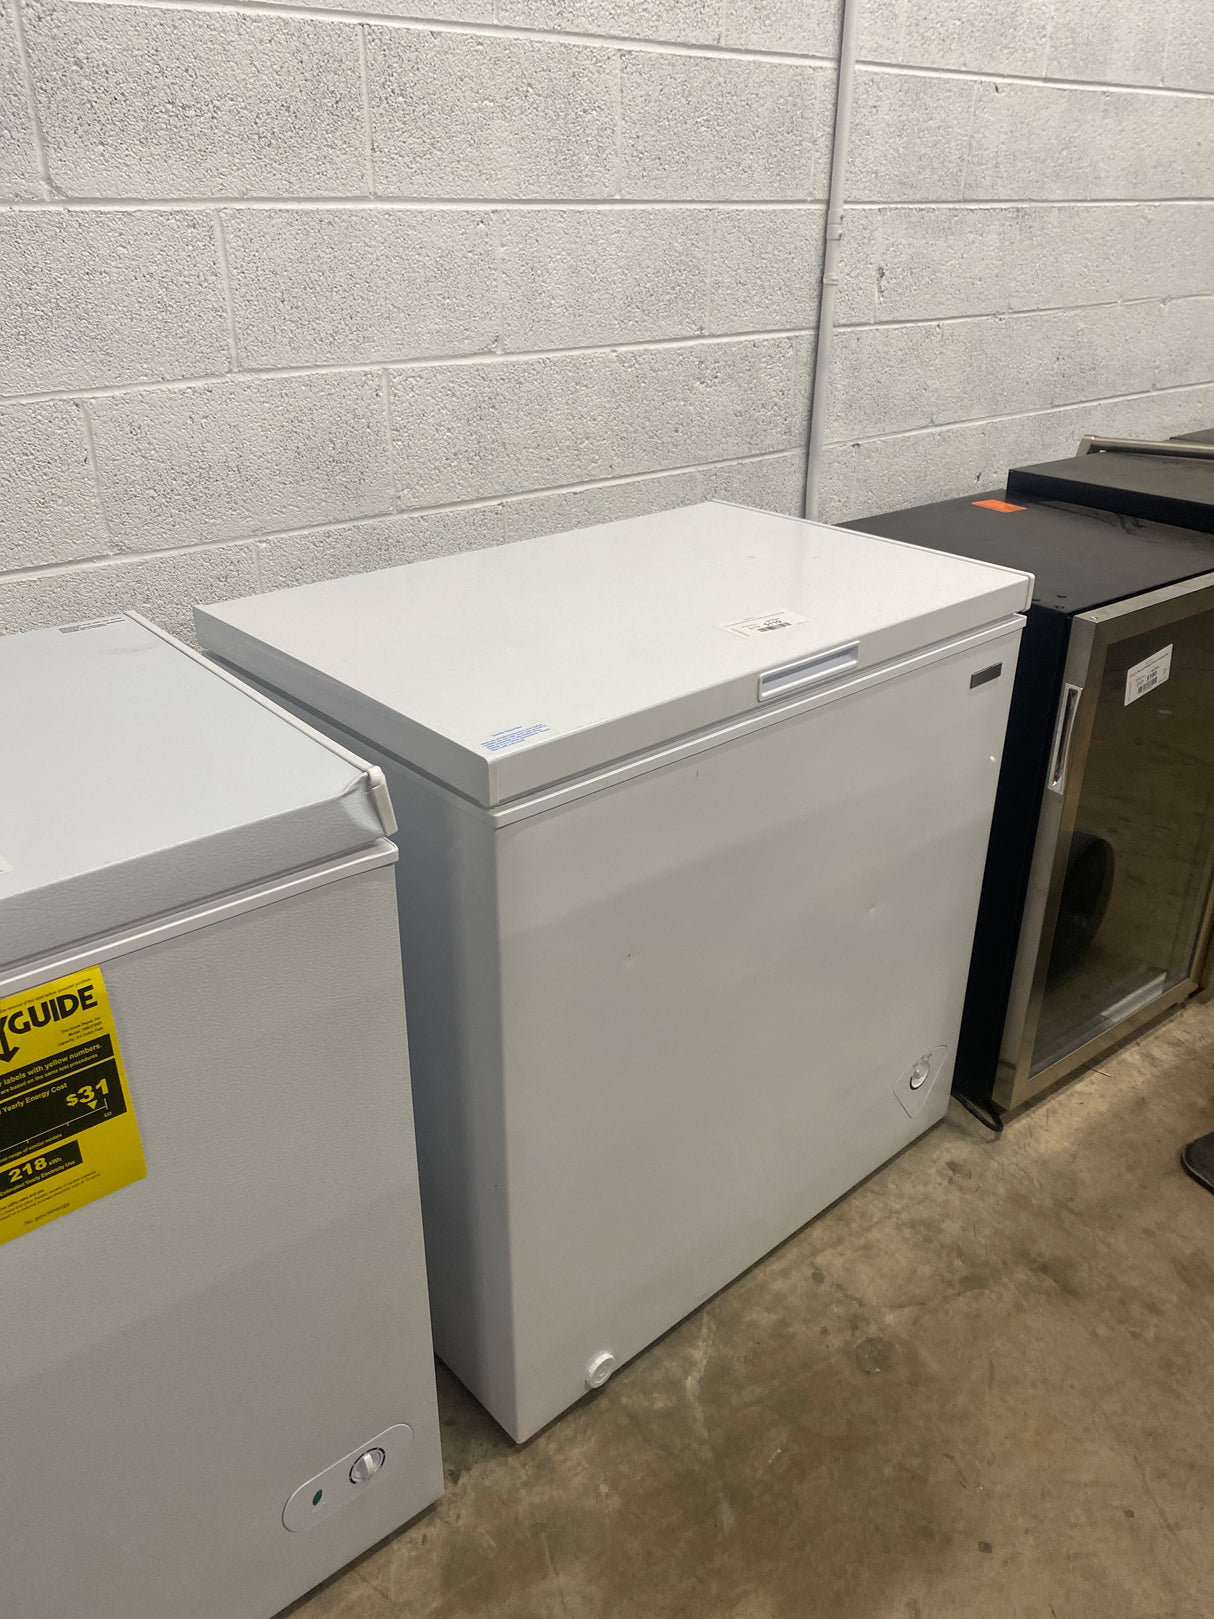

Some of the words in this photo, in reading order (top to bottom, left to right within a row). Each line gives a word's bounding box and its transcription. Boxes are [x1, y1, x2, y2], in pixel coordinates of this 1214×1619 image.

[4, 1072, 26, 1085] labels
[28, 1065, 44, 1076] with
[45, 1056, 68, 1070] yellow
[69, 1044, 102, 1059] numbers.
[2, 1100, 24, 1113] Yearly
[25, 1090, 50, 1104] Energy
[51, 1083, 68, 1093] Cost
[66, 1078, 109, 1106] $31
[9, 1158, 48, 1182] 218
